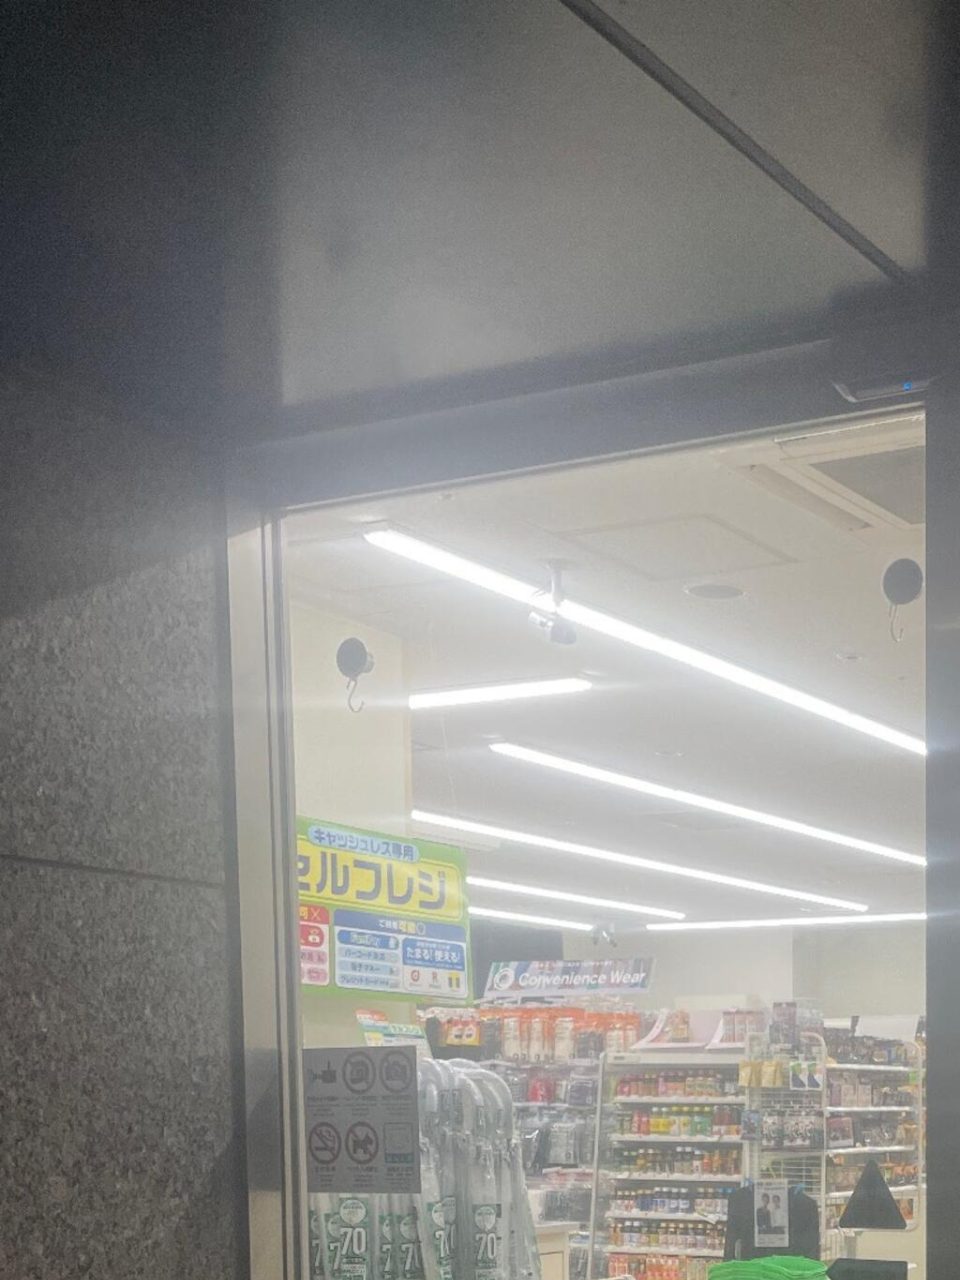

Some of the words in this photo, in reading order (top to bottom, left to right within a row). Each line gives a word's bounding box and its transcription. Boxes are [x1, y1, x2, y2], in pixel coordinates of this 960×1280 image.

[518, 971, 607, 987] Convenience
[610, 970, 646, 984] Wear
[339, 1227, 367, 1255] 70
[475, 1232, 497, 1261] 70
